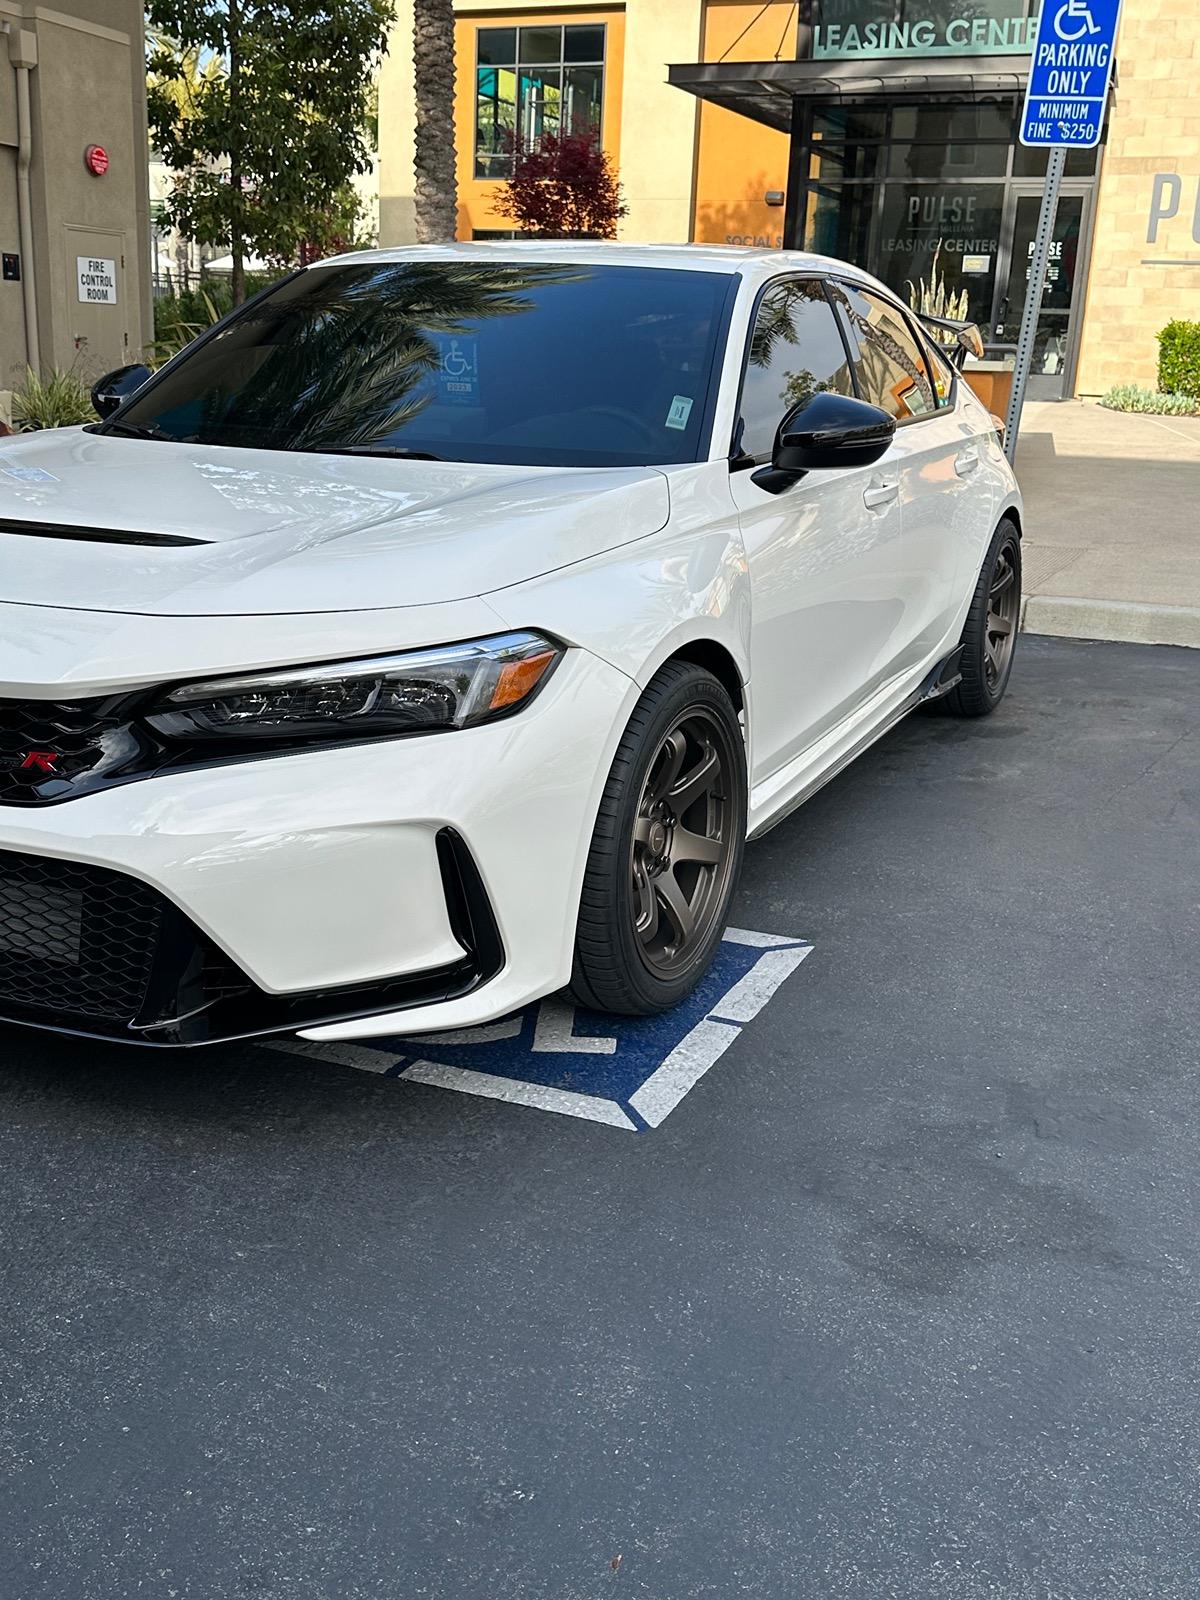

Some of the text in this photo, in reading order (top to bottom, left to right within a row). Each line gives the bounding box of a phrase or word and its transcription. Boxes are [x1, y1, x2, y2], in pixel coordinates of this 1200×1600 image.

[814, 20, 936, 50] LEASING
[1037, 43, 1108, 67] PARKING
[1047, 70, 1091, 94] ONLY
[1038, 103, 1089, 119] MINIMUM
[1027, 122, 1094, 140] FINE $250
[908, 196, 977, 223] PULSE
[726, 235, 771, 248] SOCIAL
[881, 239, 997, 252] LEASING CENTER
[1028, 242, 1062, 256] PSE
[88, 260, 105, 273] FIRE
[80, 273, 113, 288] CONTROL
[86, 288, 109, 301] ROOM
